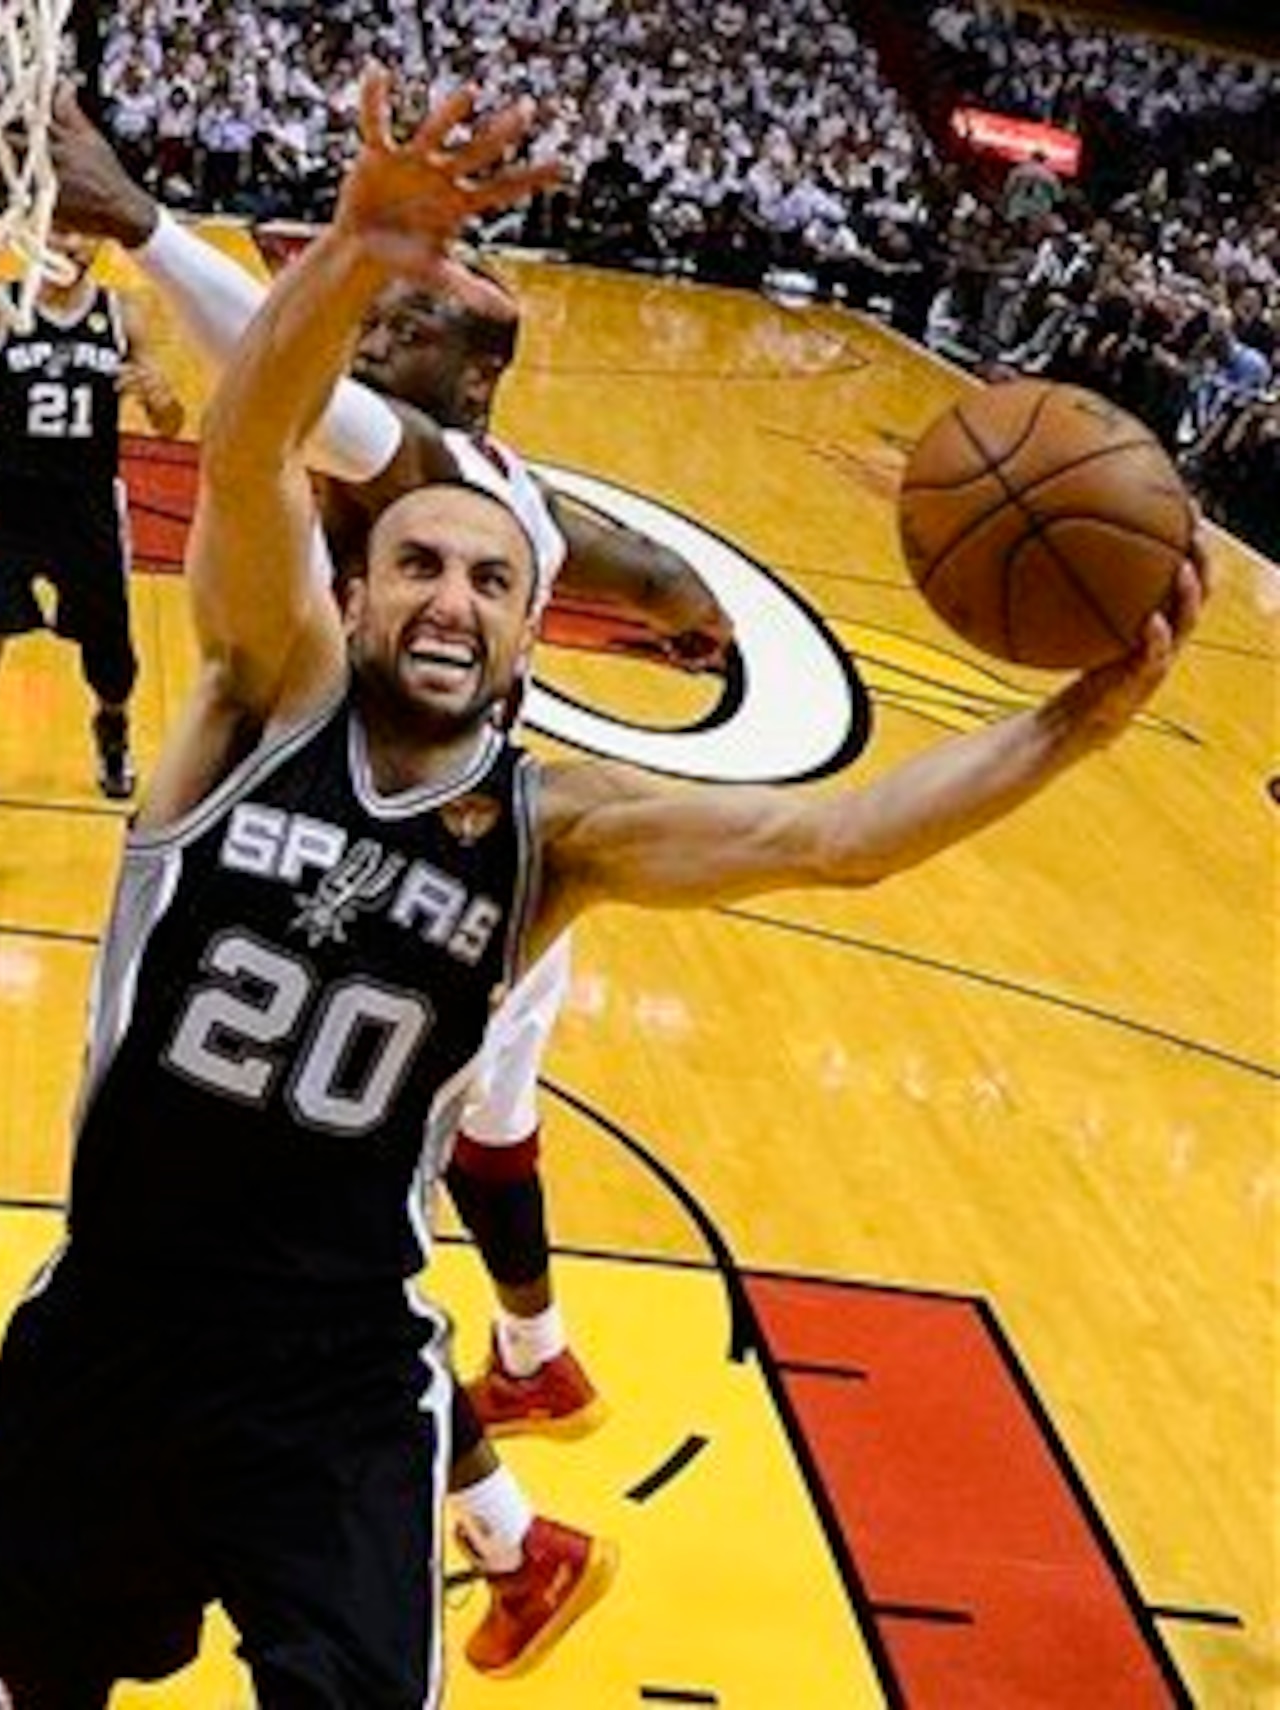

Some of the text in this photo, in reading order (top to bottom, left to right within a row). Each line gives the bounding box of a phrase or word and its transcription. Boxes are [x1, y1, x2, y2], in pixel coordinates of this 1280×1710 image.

[6, 342, 120, 375] SPURS
[27, 381, 94, 438] 21
[219, 801, 501, 965] SPURS
[160, 926, 432, 1135] 20
